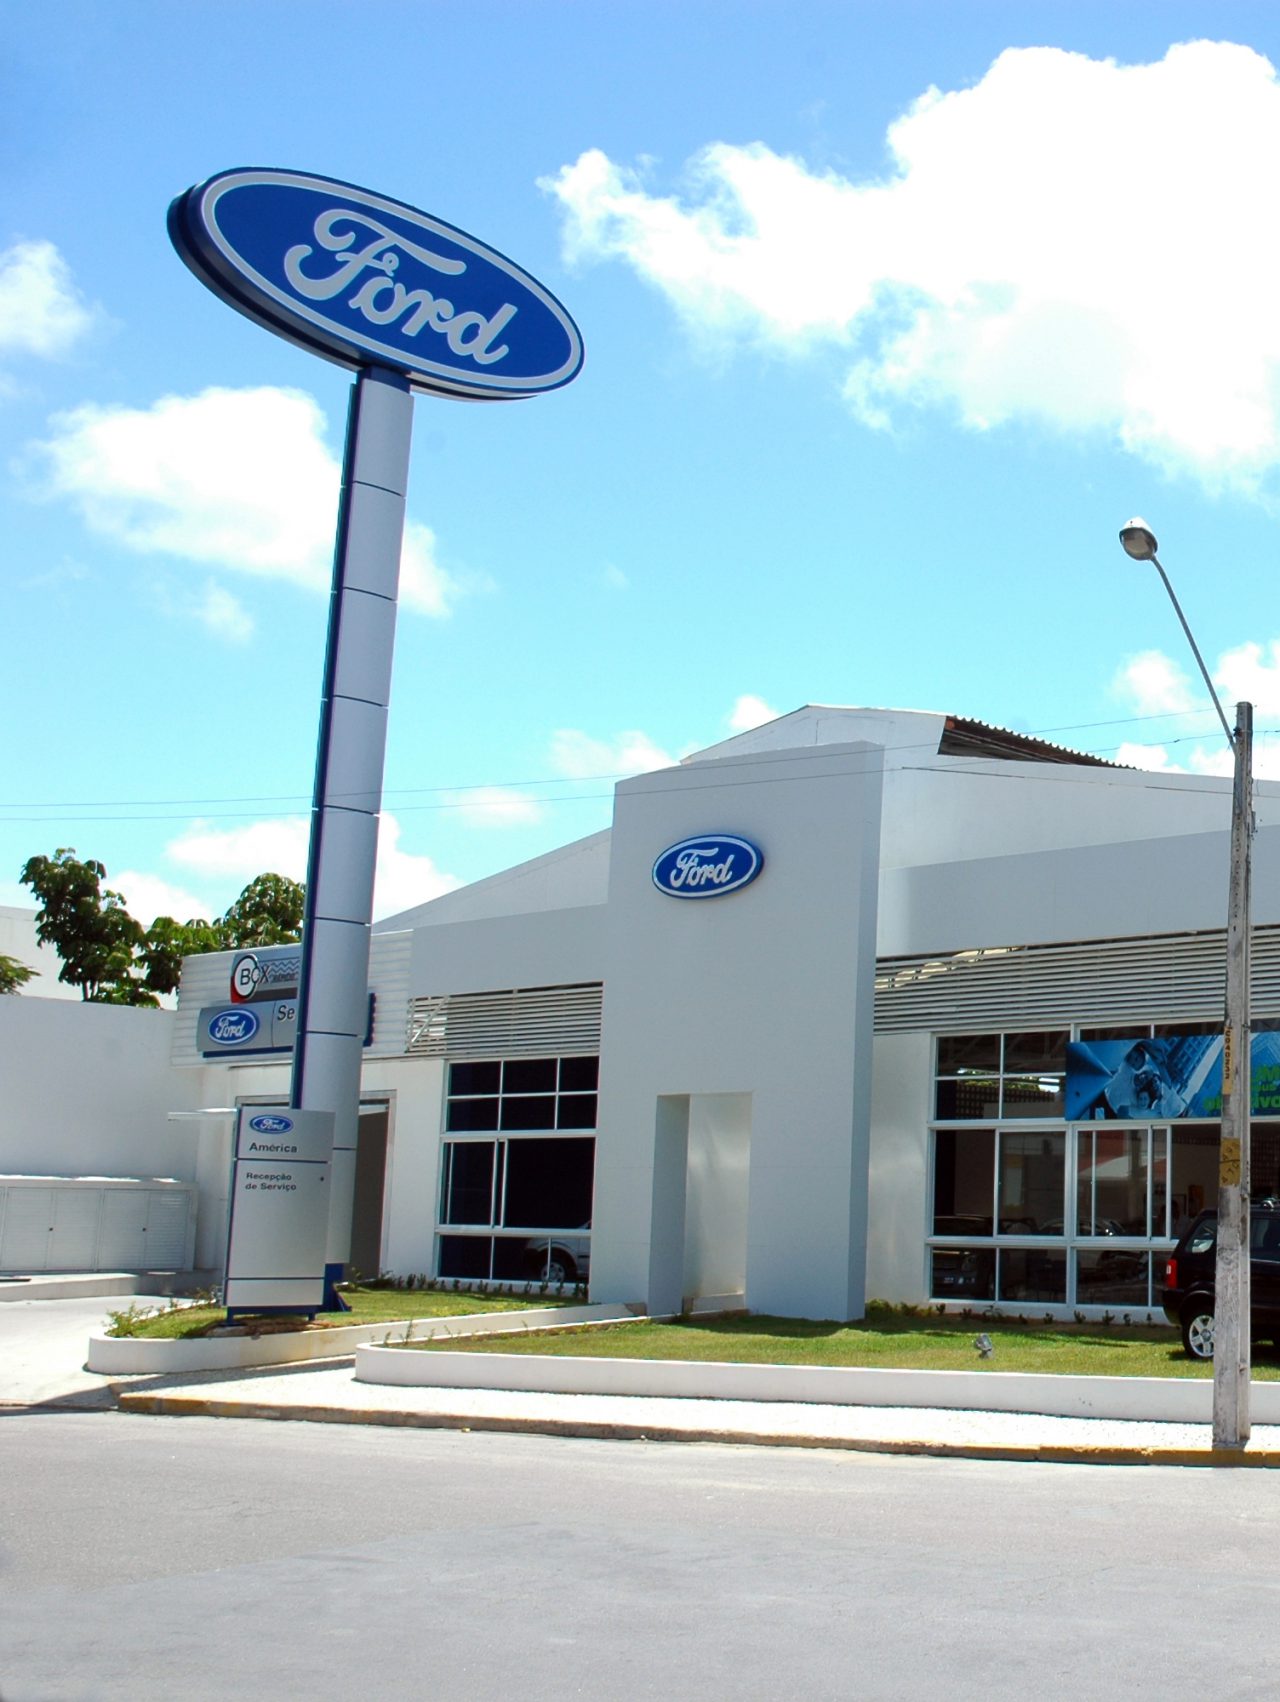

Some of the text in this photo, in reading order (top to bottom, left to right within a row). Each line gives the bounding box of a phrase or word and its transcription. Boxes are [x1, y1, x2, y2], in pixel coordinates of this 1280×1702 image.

[283, 208, 518, 365] Ford
[670, 847, 735, 888] Ford
[240, 965, 271, 986] BOX
[215, 1015, 246, 1038] Ford
[260, 1118, 286, 1131] Ford
[249, 1142, 298, 1153] América
[246, 1172, 292, 1181] Recepção
[260, 1183, 297, 1192] Serviço
